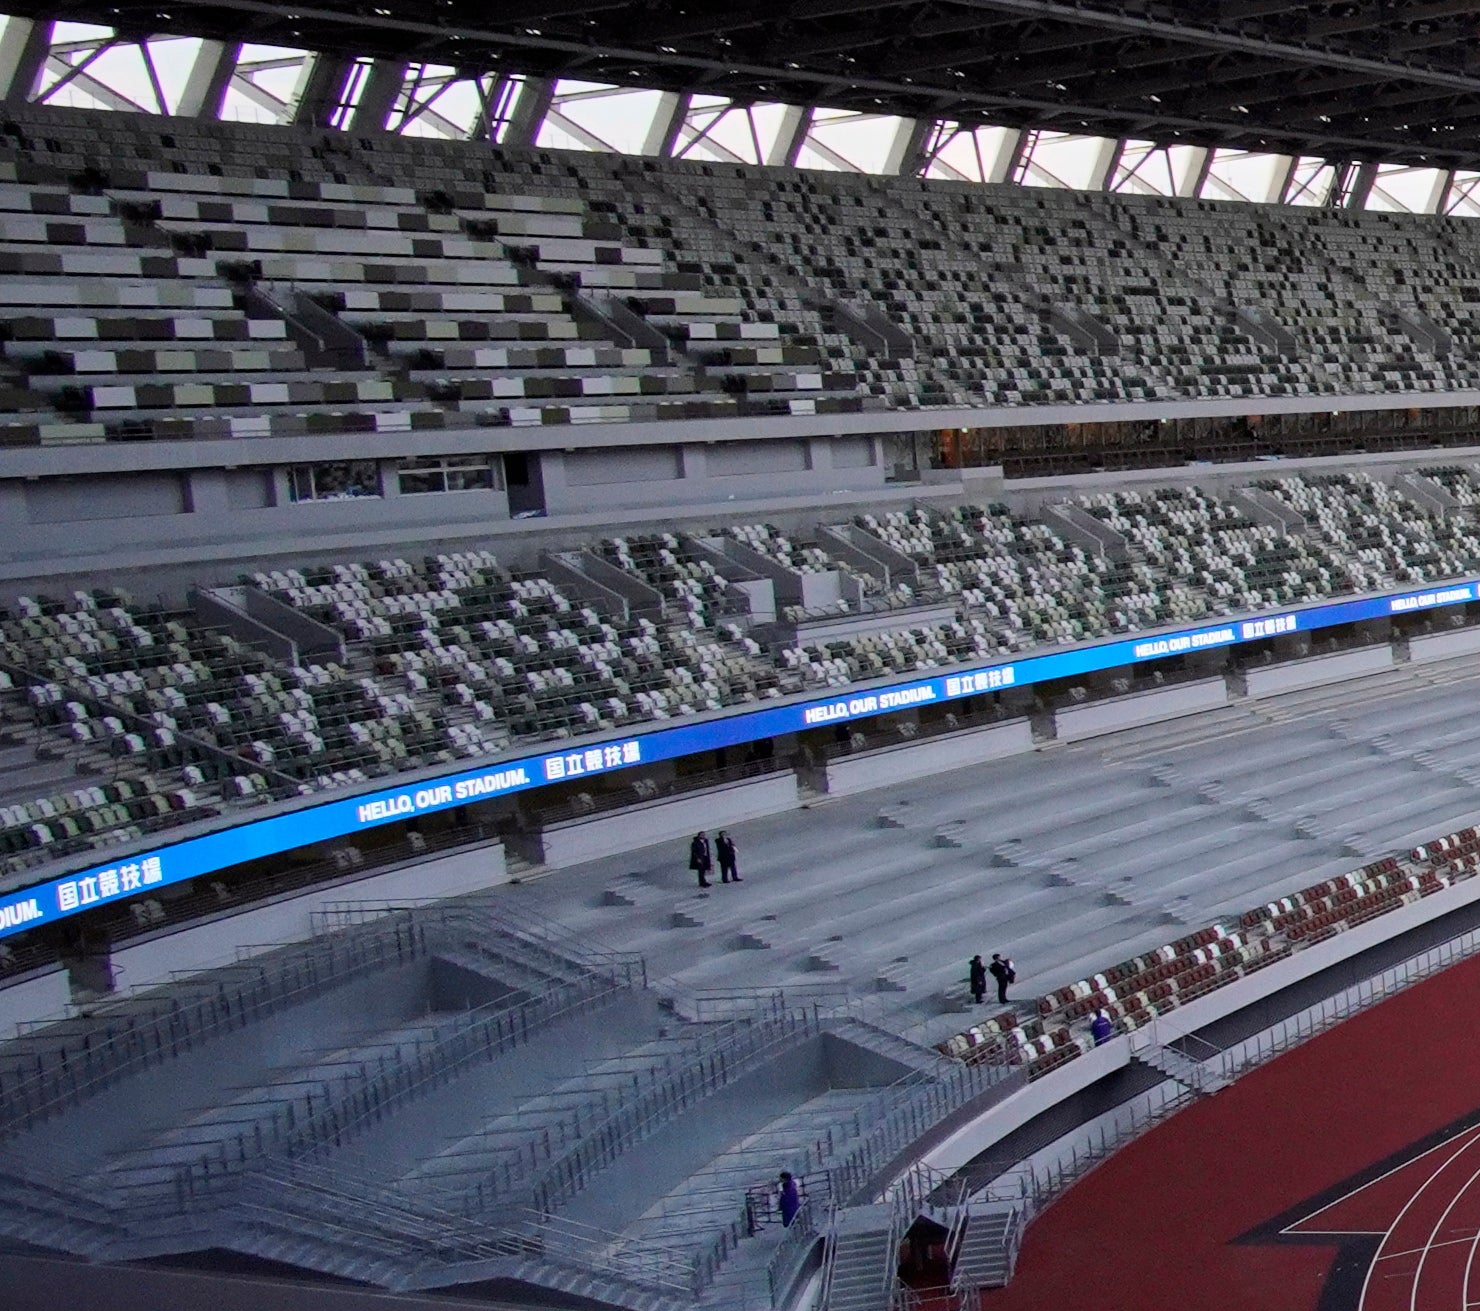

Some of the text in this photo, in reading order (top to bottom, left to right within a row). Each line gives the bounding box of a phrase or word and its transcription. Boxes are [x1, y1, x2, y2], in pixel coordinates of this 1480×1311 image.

[806, 686, 935, 723] HELLO, OUR STADIUM.
[359, 769, 529, 821] HELLO, OUR STADIUM.
[58, 857, 161, 910] 国立競技場
